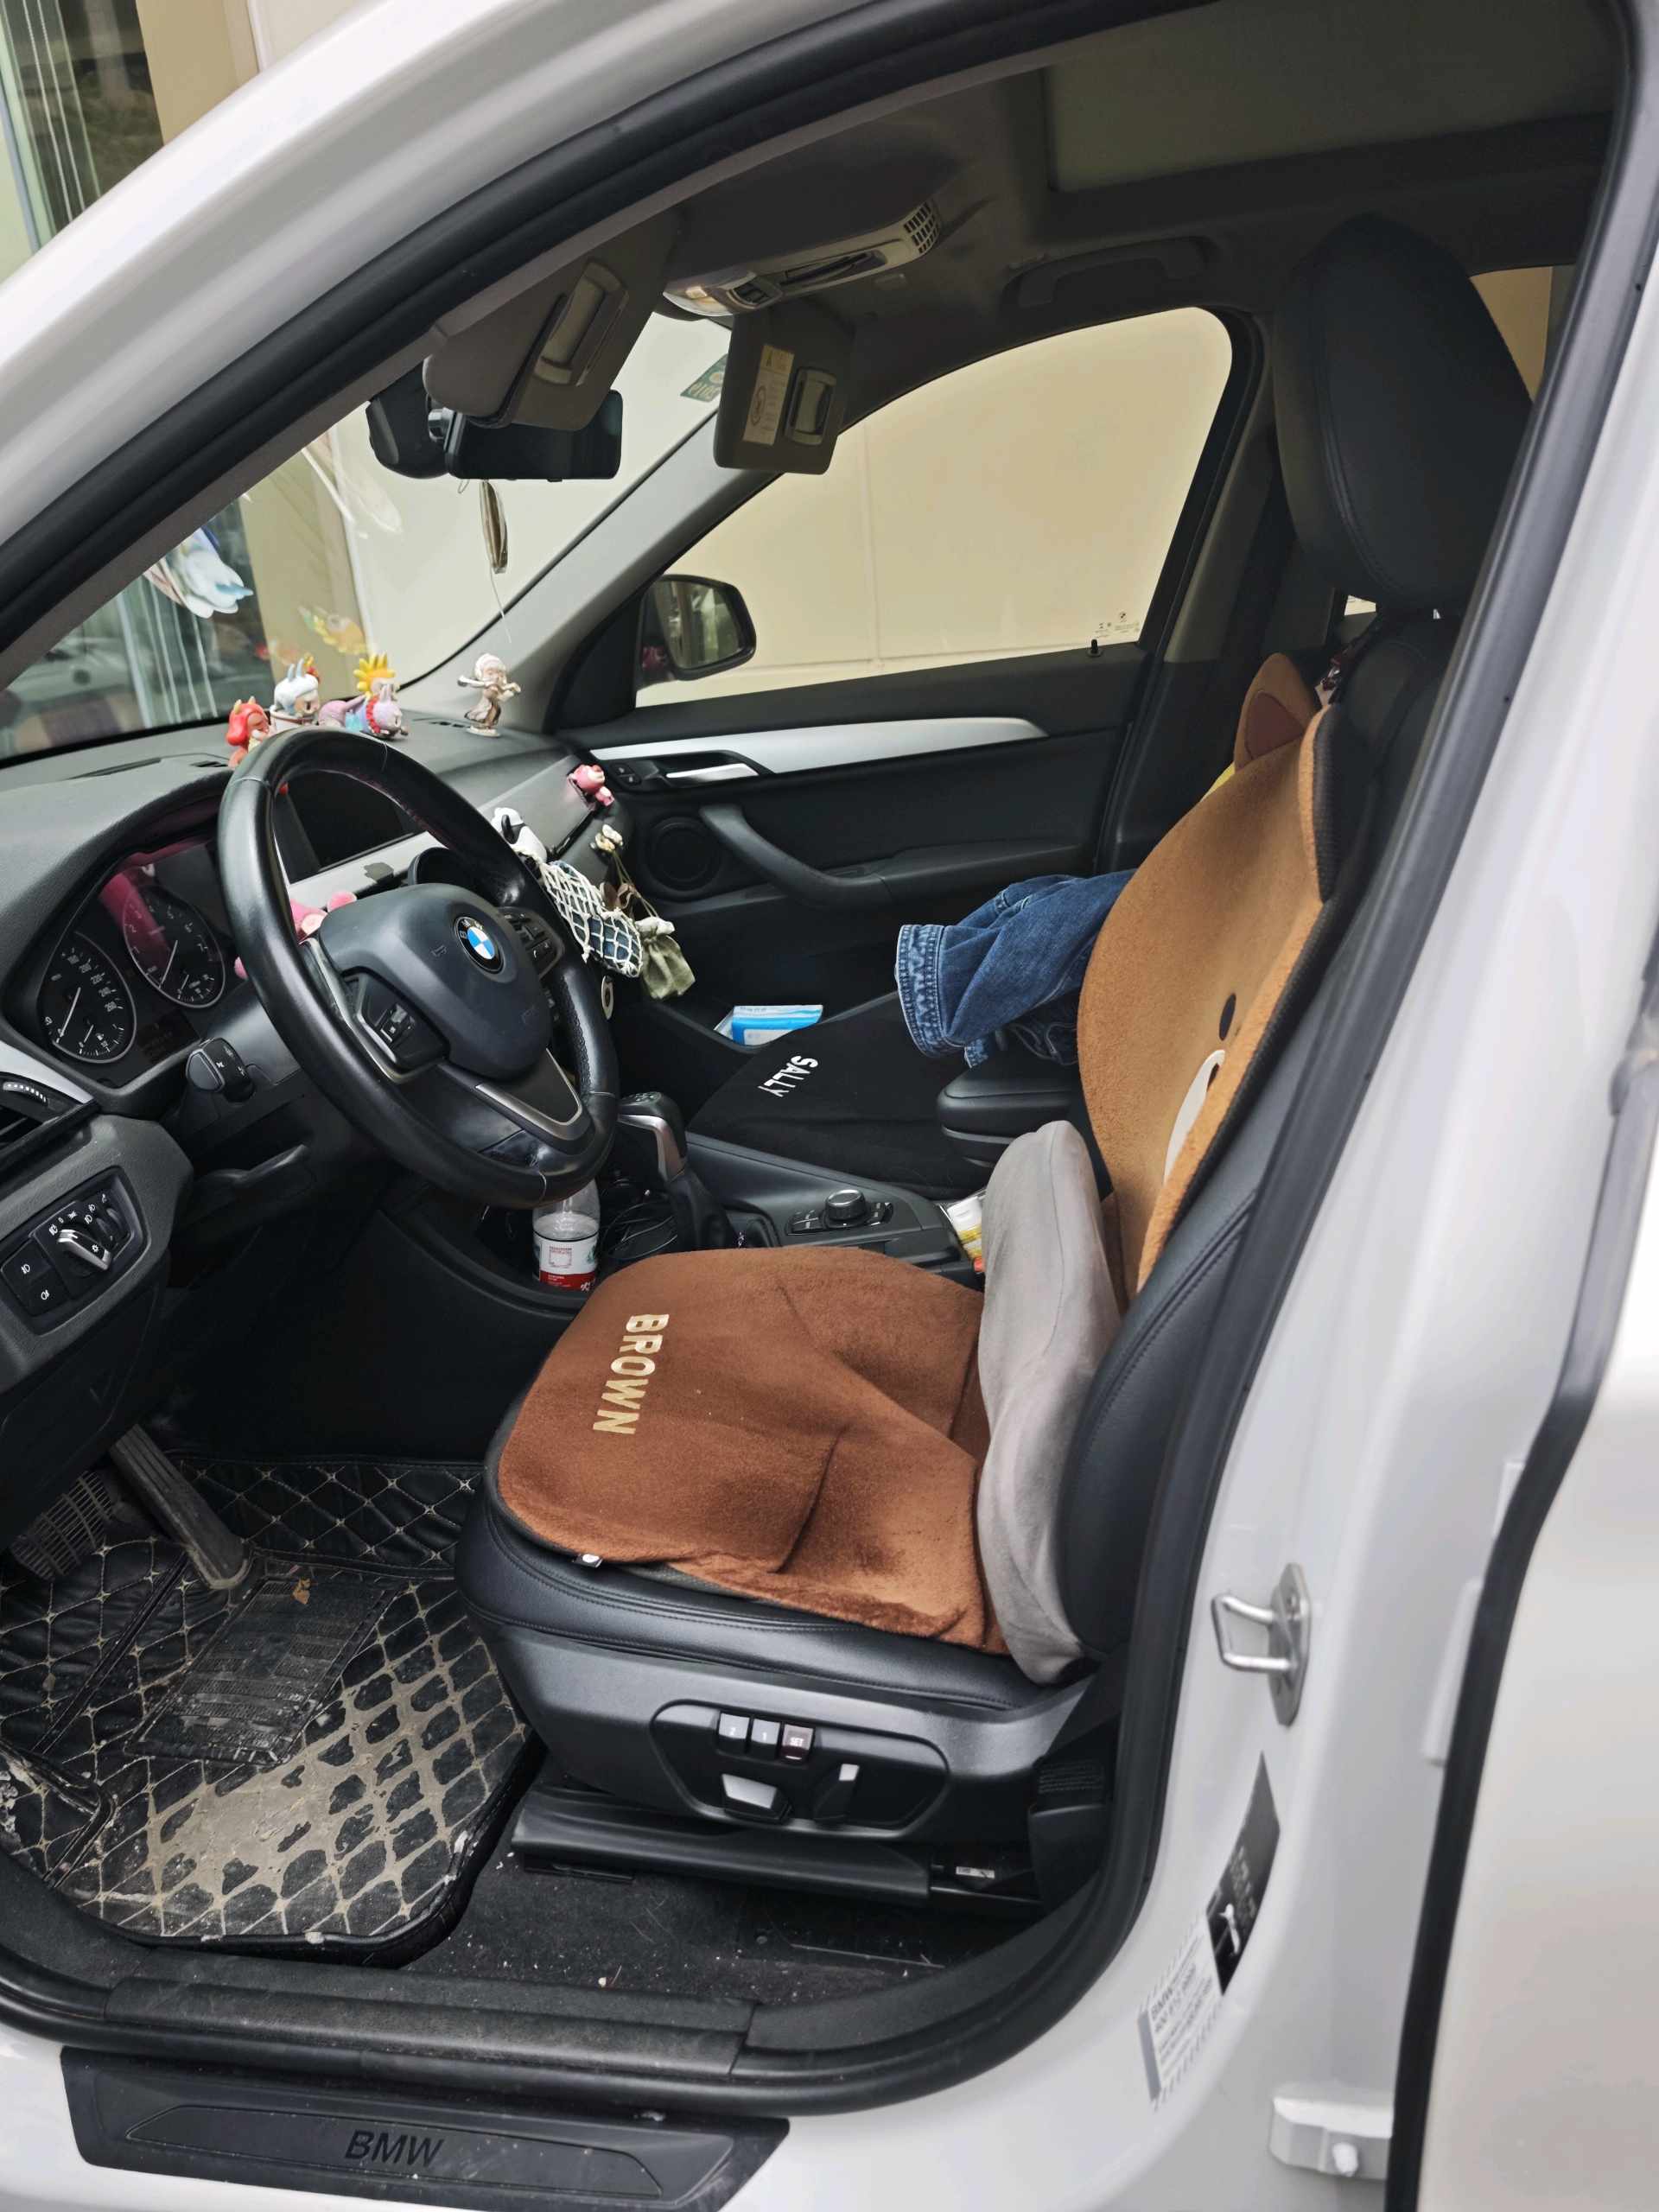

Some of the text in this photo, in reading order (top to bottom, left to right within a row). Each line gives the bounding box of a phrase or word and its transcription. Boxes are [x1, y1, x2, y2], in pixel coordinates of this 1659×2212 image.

[460, 918, 484, 939] BMW
[758, 1055, 818, 1097] SALLY
[593, 1314, 670, 1434] BROWN
[790, 1737, 804, 1747] SET
[345, 2129, 444, 2168] BMW
